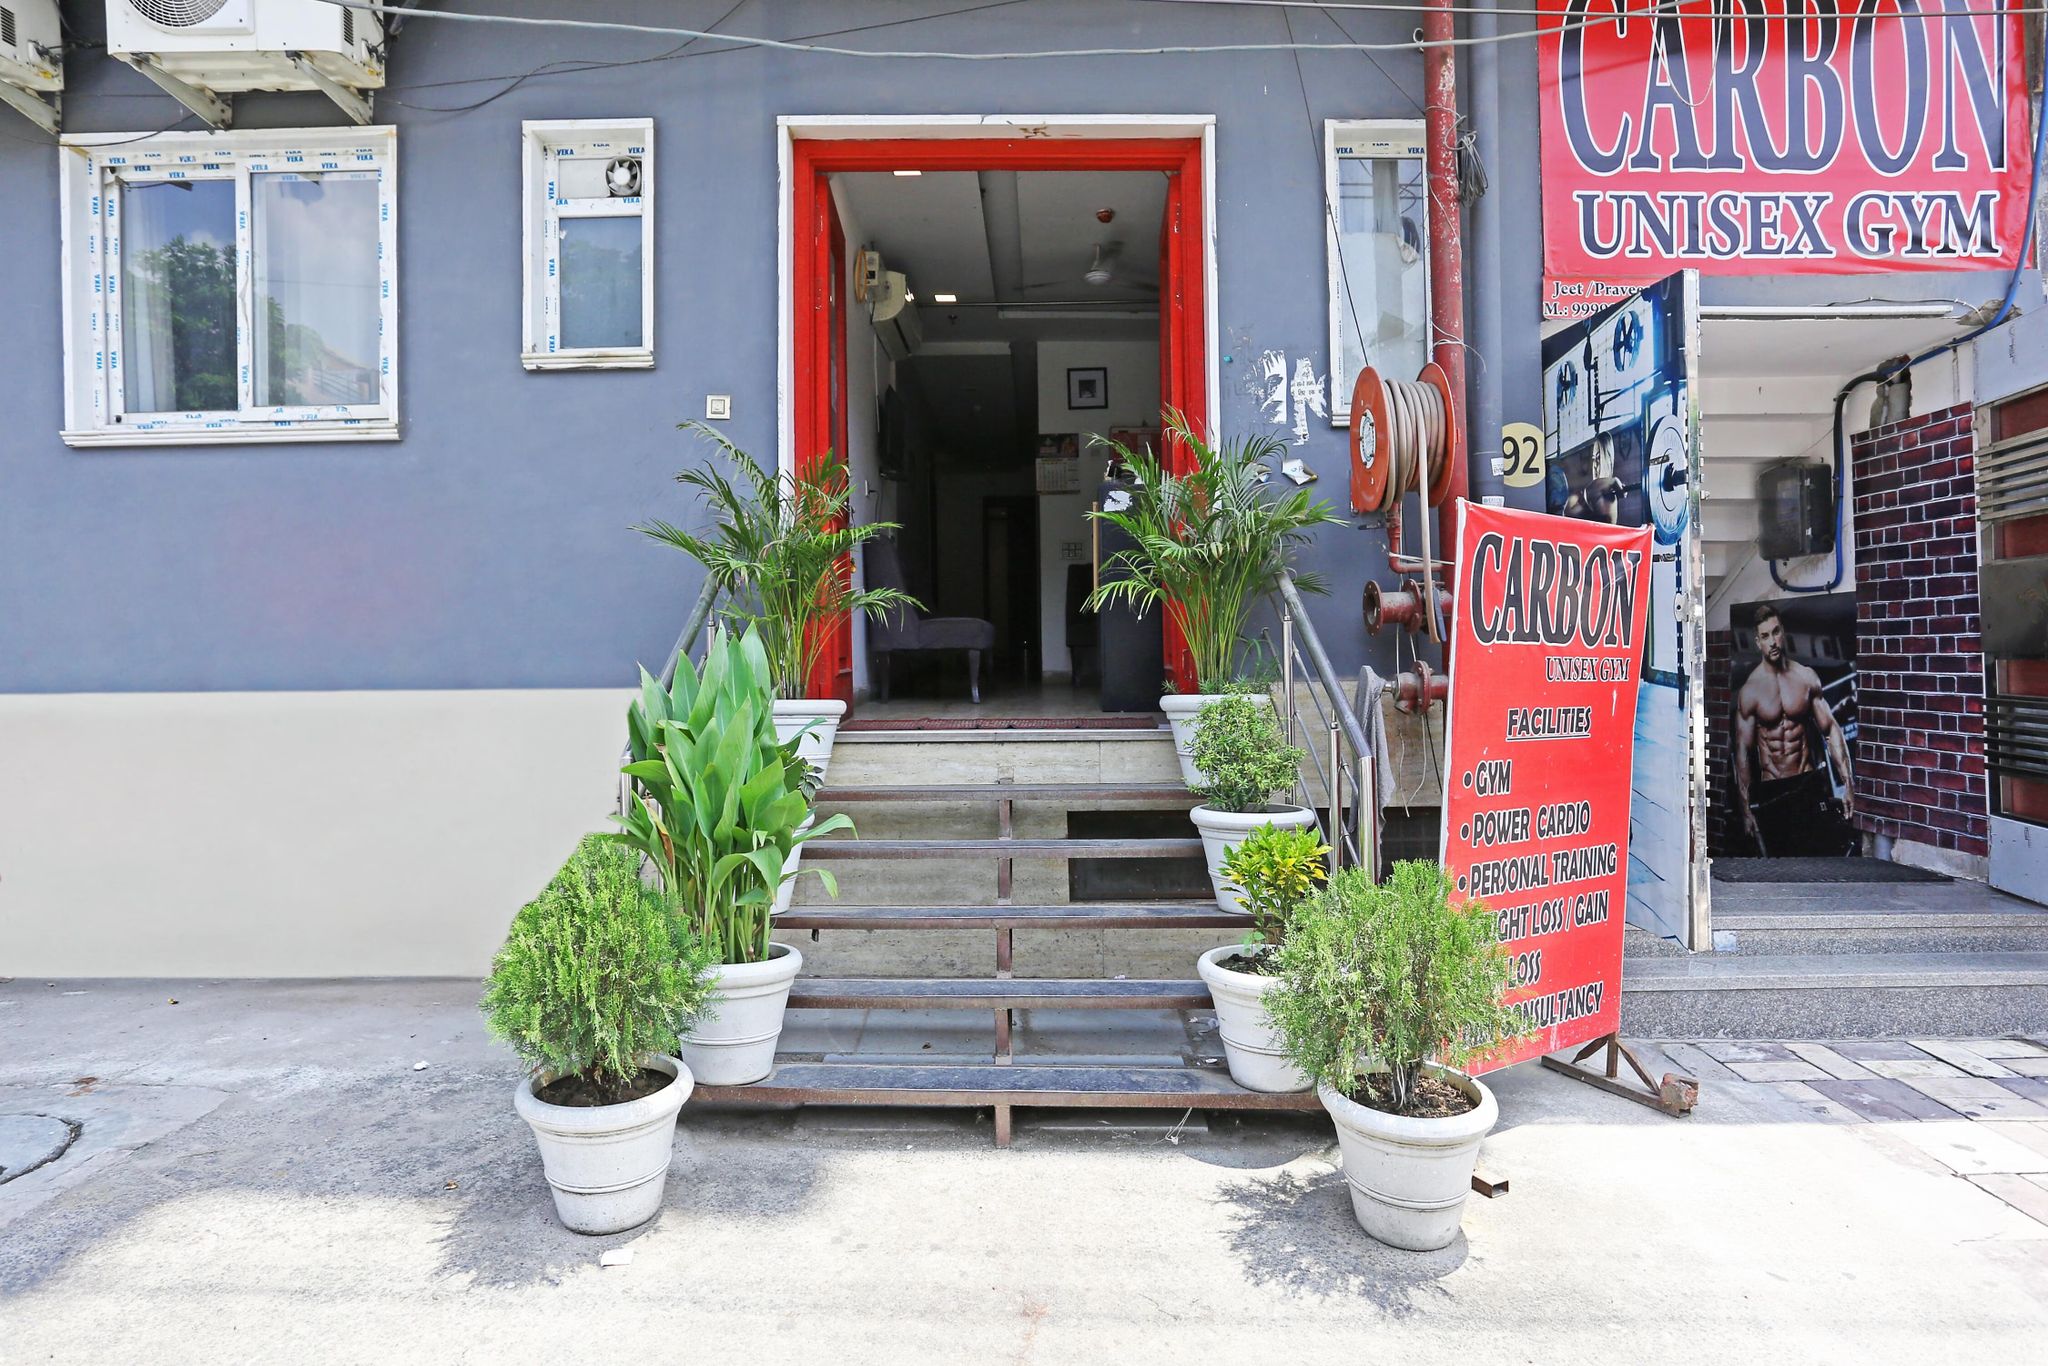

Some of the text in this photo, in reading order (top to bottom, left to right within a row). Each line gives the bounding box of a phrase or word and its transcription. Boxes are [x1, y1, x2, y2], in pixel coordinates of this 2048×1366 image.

[1559, 0, 2008, 177] CARBON
[557, 148, 574, 156] VEKA
[1573, 190, 2002, 259] UNISEX GYM
[1552, 281, 1584, 298] Jeet
[1572, 302, 1613, 316] 9999
[1502, 435, 1540, 476] 92
[1471, 532, 1641, 648] CARBON
[1546, 657, 1630, 682] UNISEX GYM
[1507, 707, 1592, 737] FACILITIES
[1475, 760, 1512, 797] GYM
[1472, 801, 1591, 848] POWER CARDIO
[1469, 844, 1617, 898] PERSONAL TRAINING
[1531, 898, 1564, 936] LOSS
[1574, 890, 1610, 927] GAIN
[1506, 949, 1542, 989] LOSS
